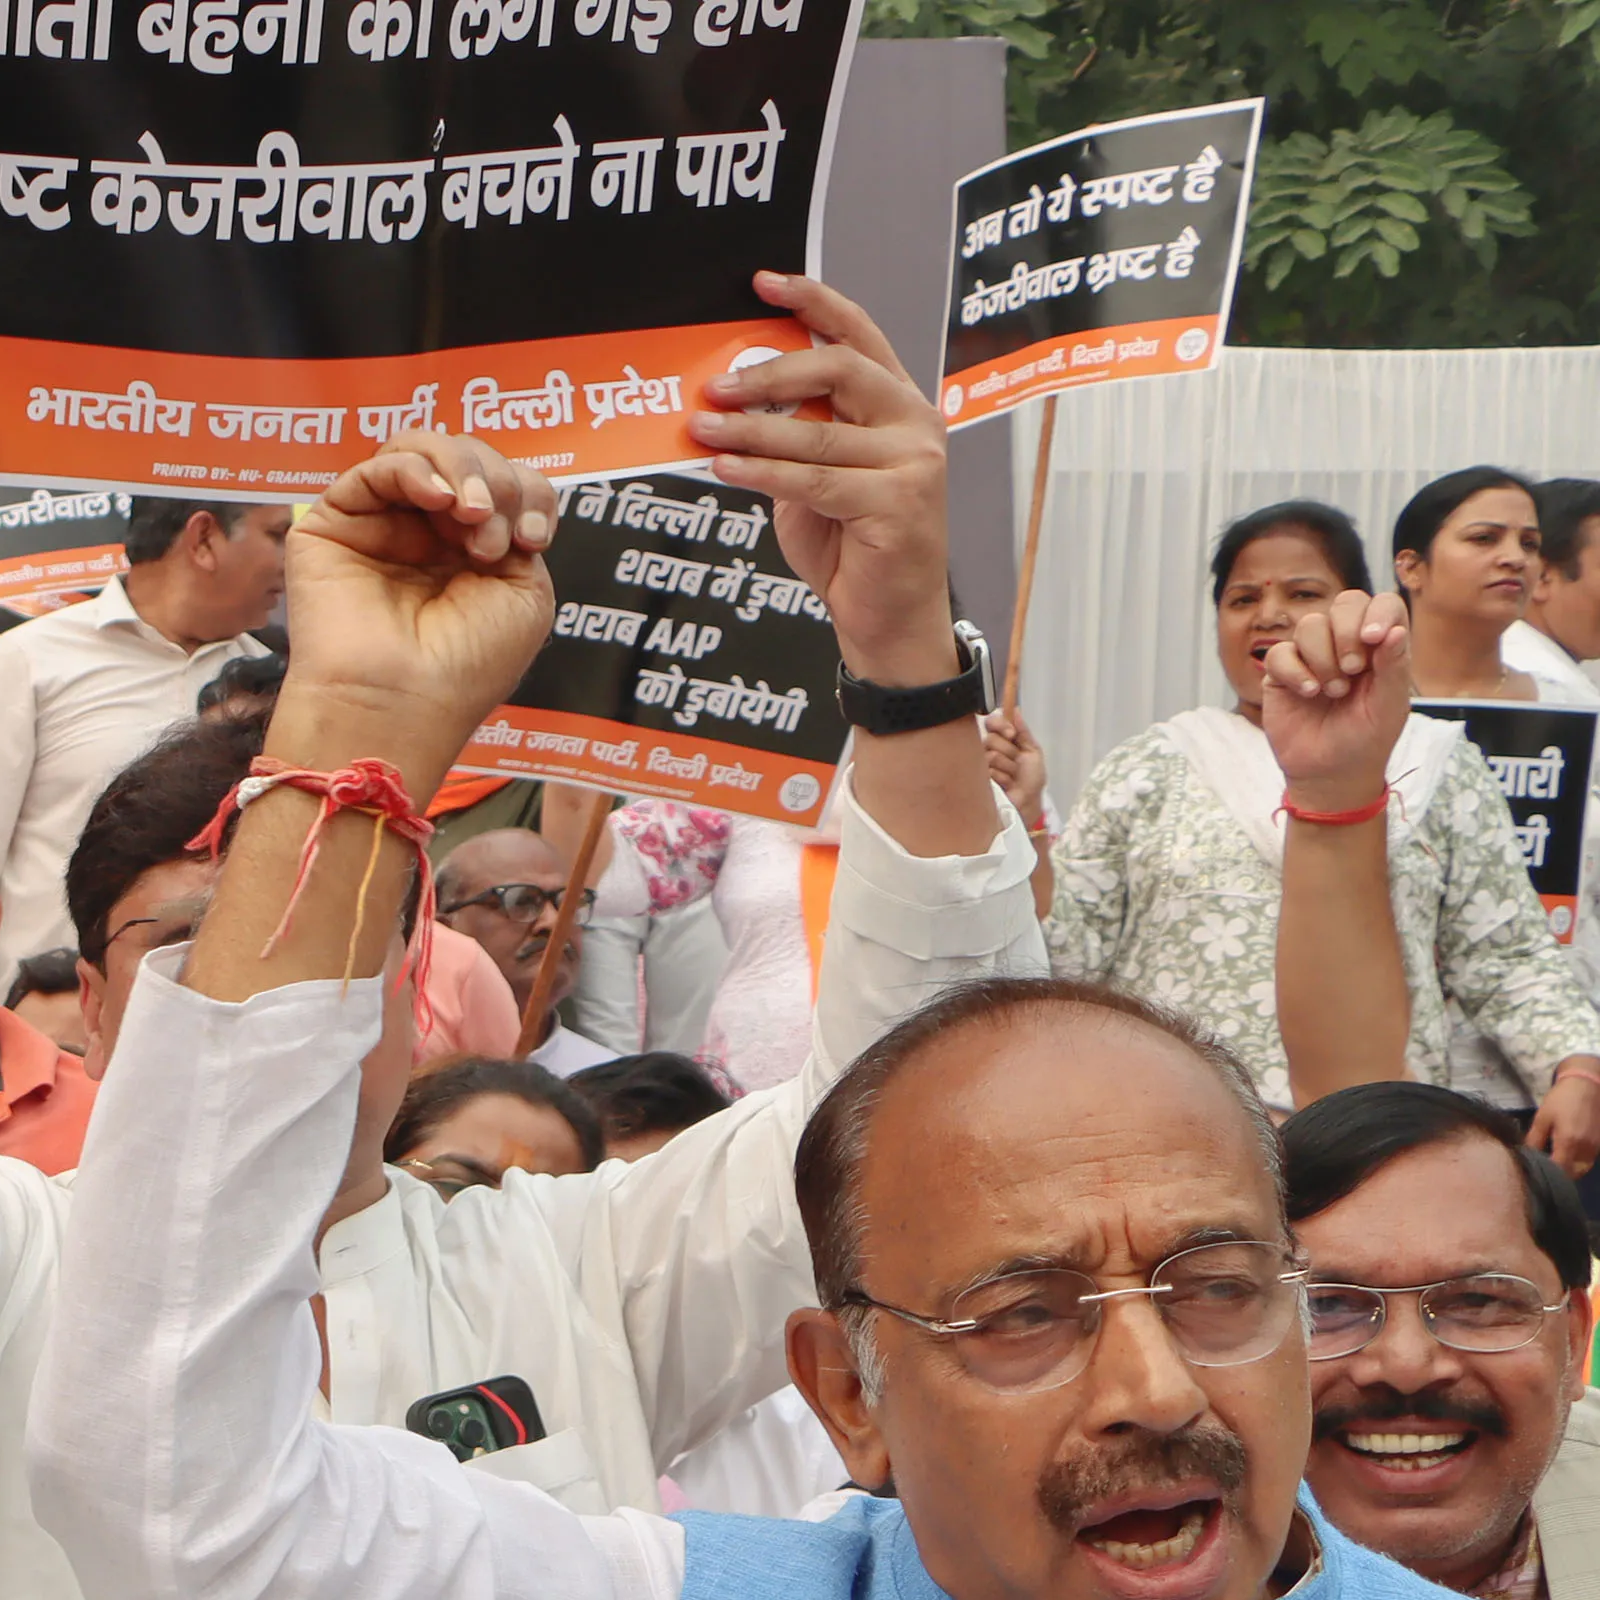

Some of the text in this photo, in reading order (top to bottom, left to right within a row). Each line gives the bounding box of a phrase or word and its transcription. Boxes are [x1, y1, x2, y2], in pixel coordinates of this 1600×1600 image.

[90, 130, 435, 244] केजरीवाल
[440, 114, 580, 230] बचने
[591, 138, 663, 214] ना
[674, 99, 787, 203] पाये
[961, 144, 1222, 258] अब तो ये स्पष्ट है
[961, 225, 1200, 326] केजरीवाल भ्रष्ट है
[27, 380, 197, 437] भारतीय
[207, 403, 346, 445] जनता
[461, 370, 575, 433] दिल्ली
[583, 365, 684, 429] प्रदेश
[152, 462, 207, 479] PRINTED
[577, 480, 617, 527] ने
[611, 481, 719, 543] दिल्ली
[715, 503, 769, 550] को
[614, 547, 833, 622] शराब में डुबाय
[553, 601, 723, 660] शराब AAP
[633, 663, 809, 734] को डुबोयेगी
[526, 728, 588, 757] जनता
[645, 749, 708, 784] दिल्ली
[707, 762, 764, 793] प्रदेश
